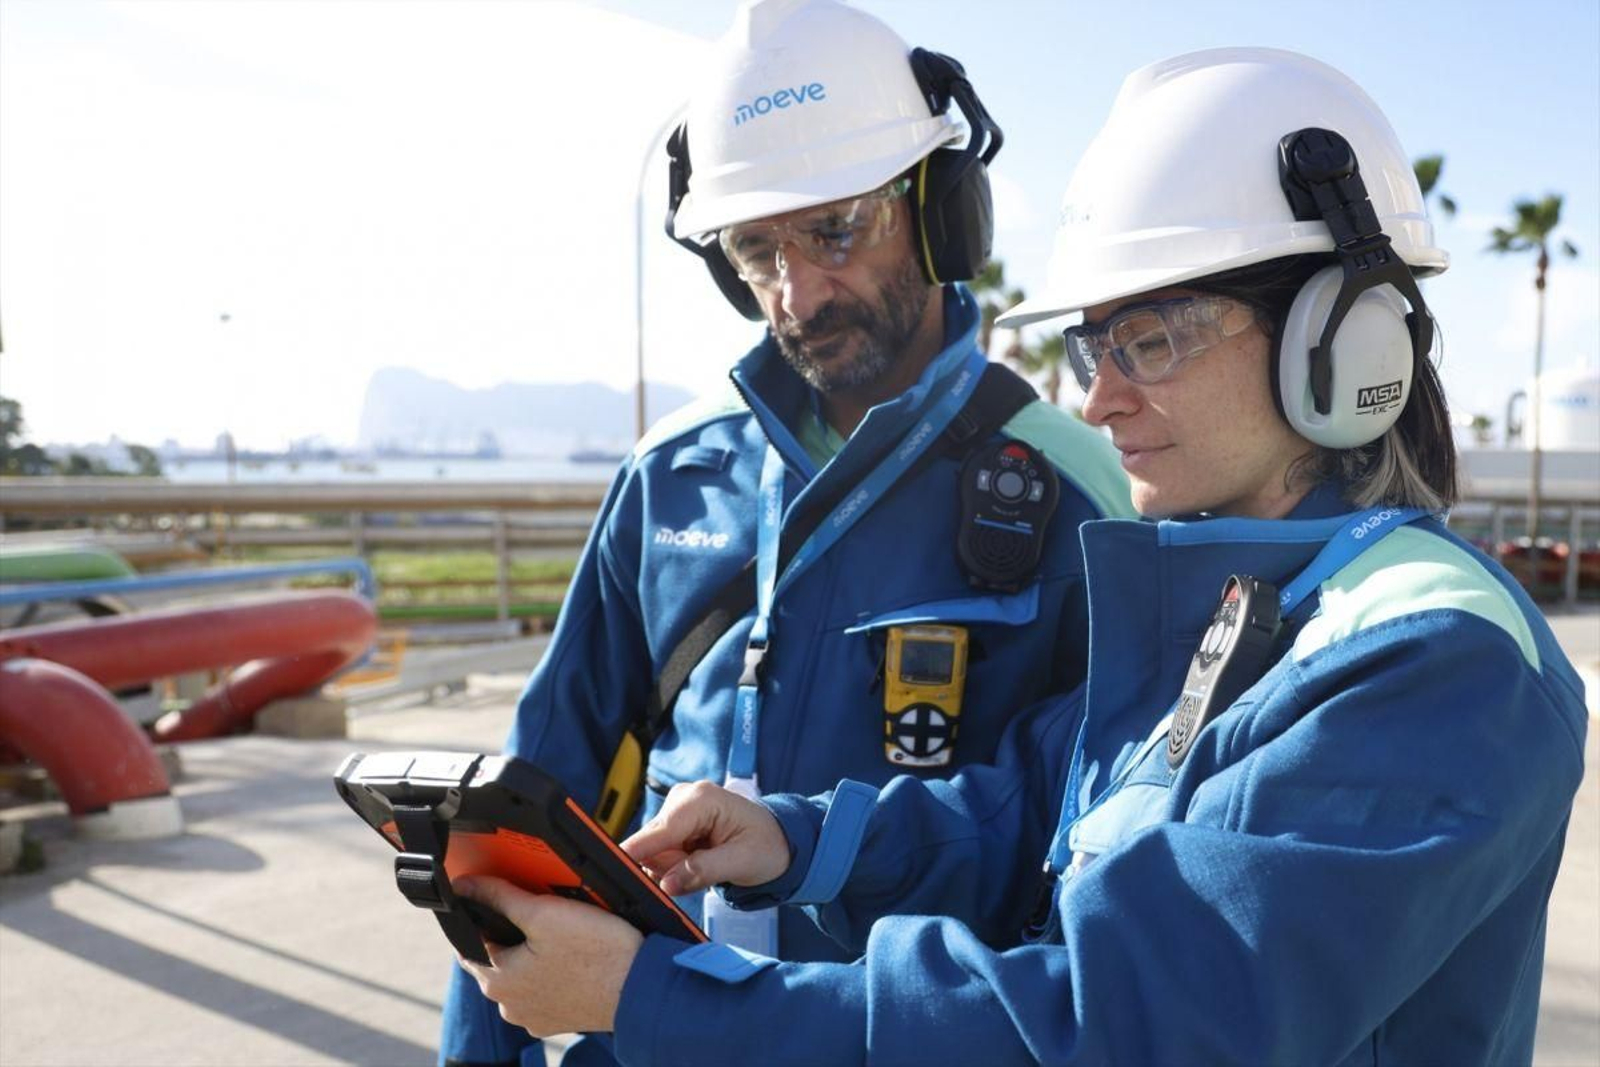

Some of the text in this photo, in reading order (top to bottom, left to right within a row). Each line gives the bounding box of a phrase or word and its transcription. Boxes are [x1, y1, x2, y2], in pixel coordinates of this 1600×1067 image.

[734, 83, 826, 126] moeve
[1360, 383, 1401, 406] MSA
[654, 527, 729, 549] moeve
